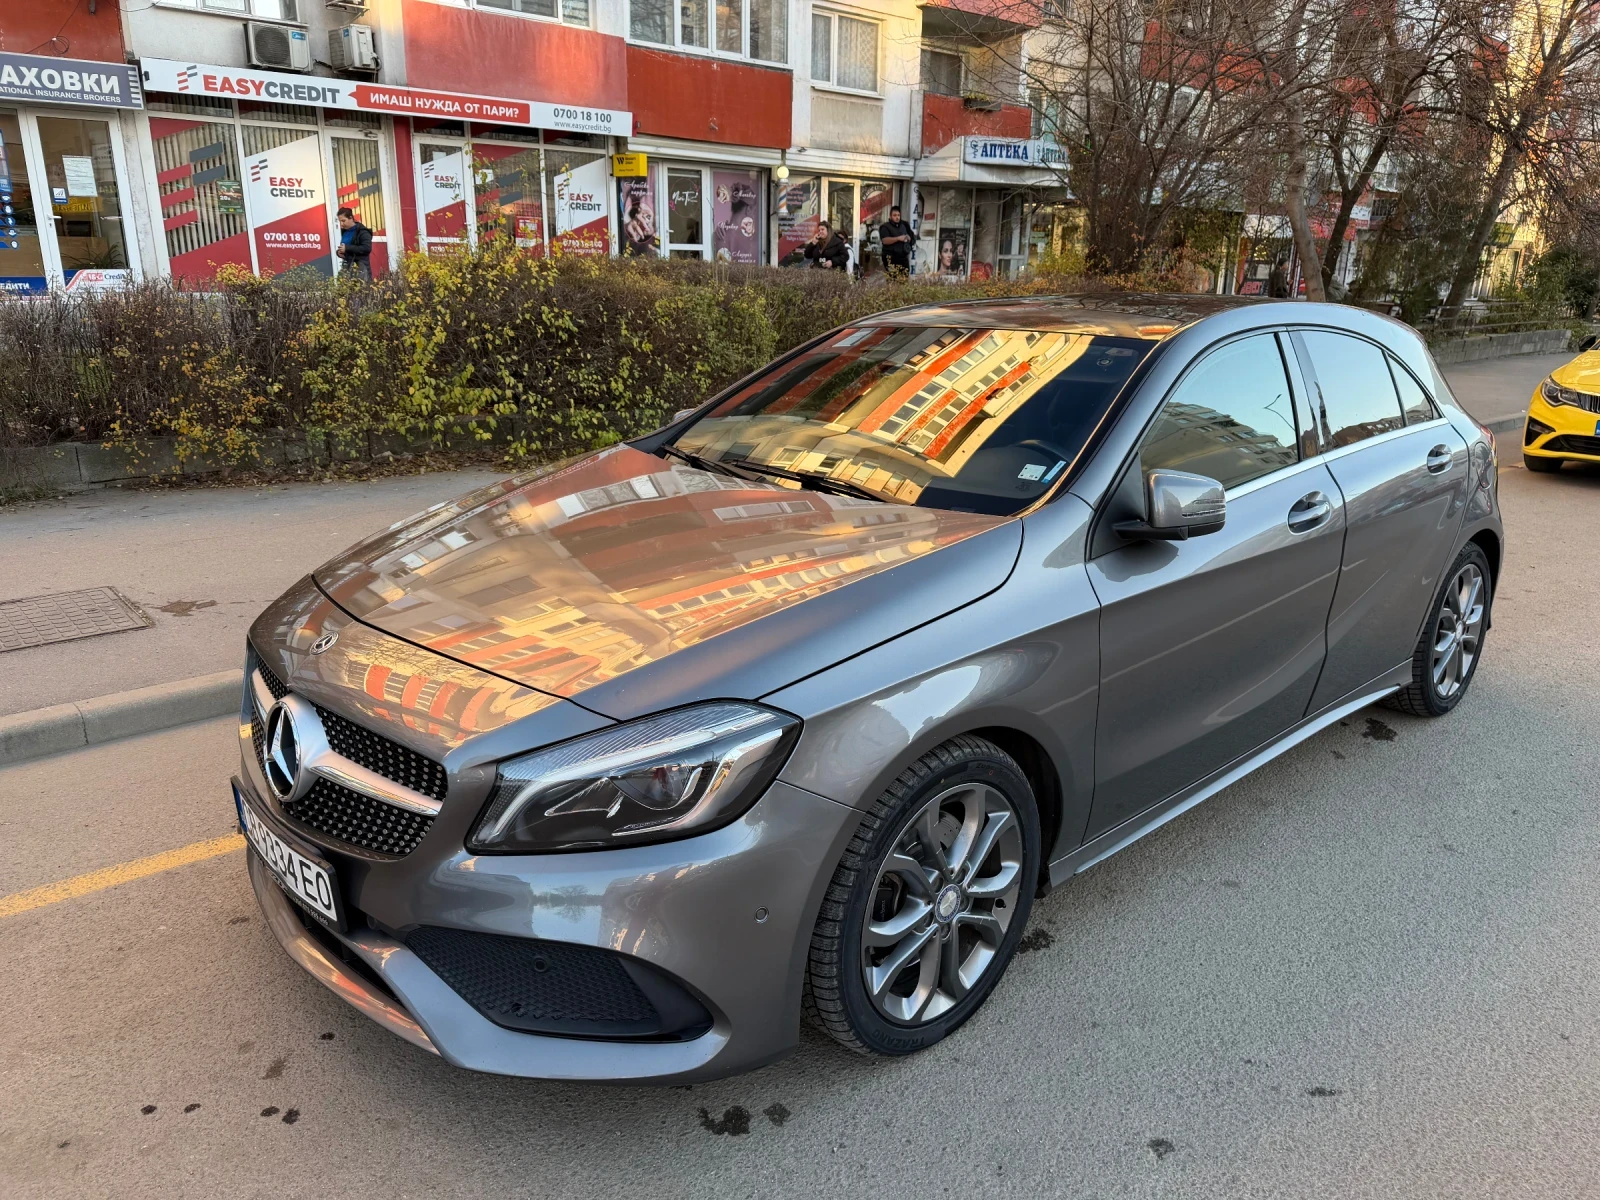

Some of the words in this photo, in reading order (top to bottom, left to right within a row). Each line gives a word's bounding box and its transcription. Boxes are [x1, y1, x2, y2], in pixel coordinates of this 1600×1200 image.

[0, 64, 120, 95] АХОВКИ
[203, 74, 340, 104] EASYCREDIT
[35, 89, 82, 99] INSURANCE
[83, 93, 121, 103] BROKERS
[370, 92, 412, 107] ИМАШ
[415, 97, 461, 113] НУЖДА
[464, 102, 479, 114] ОТ
[482, 104, 519, 119] ПАРИ?
[553, 107, 578, 120] 0700
[580, 109, 592, 121] 18
[595, 110, 612, 123] 100
[553, 121, 612, 133] www.easycredit.bg
[980, 142, 1029, 160] АПТЕКА
[269, 176, 303, 188] EASY
[270, 187, 315, 199] CREDIT
[569, 193, 594, 202] EASY
[569, 202, 602, 212] CREDIT
[263, 232, 288, 241] 0700
[289, 233, 301, 241] 18
[303, 233, 321, 242] 100
[265, 242, 321, 250] www.easycredit.bg
